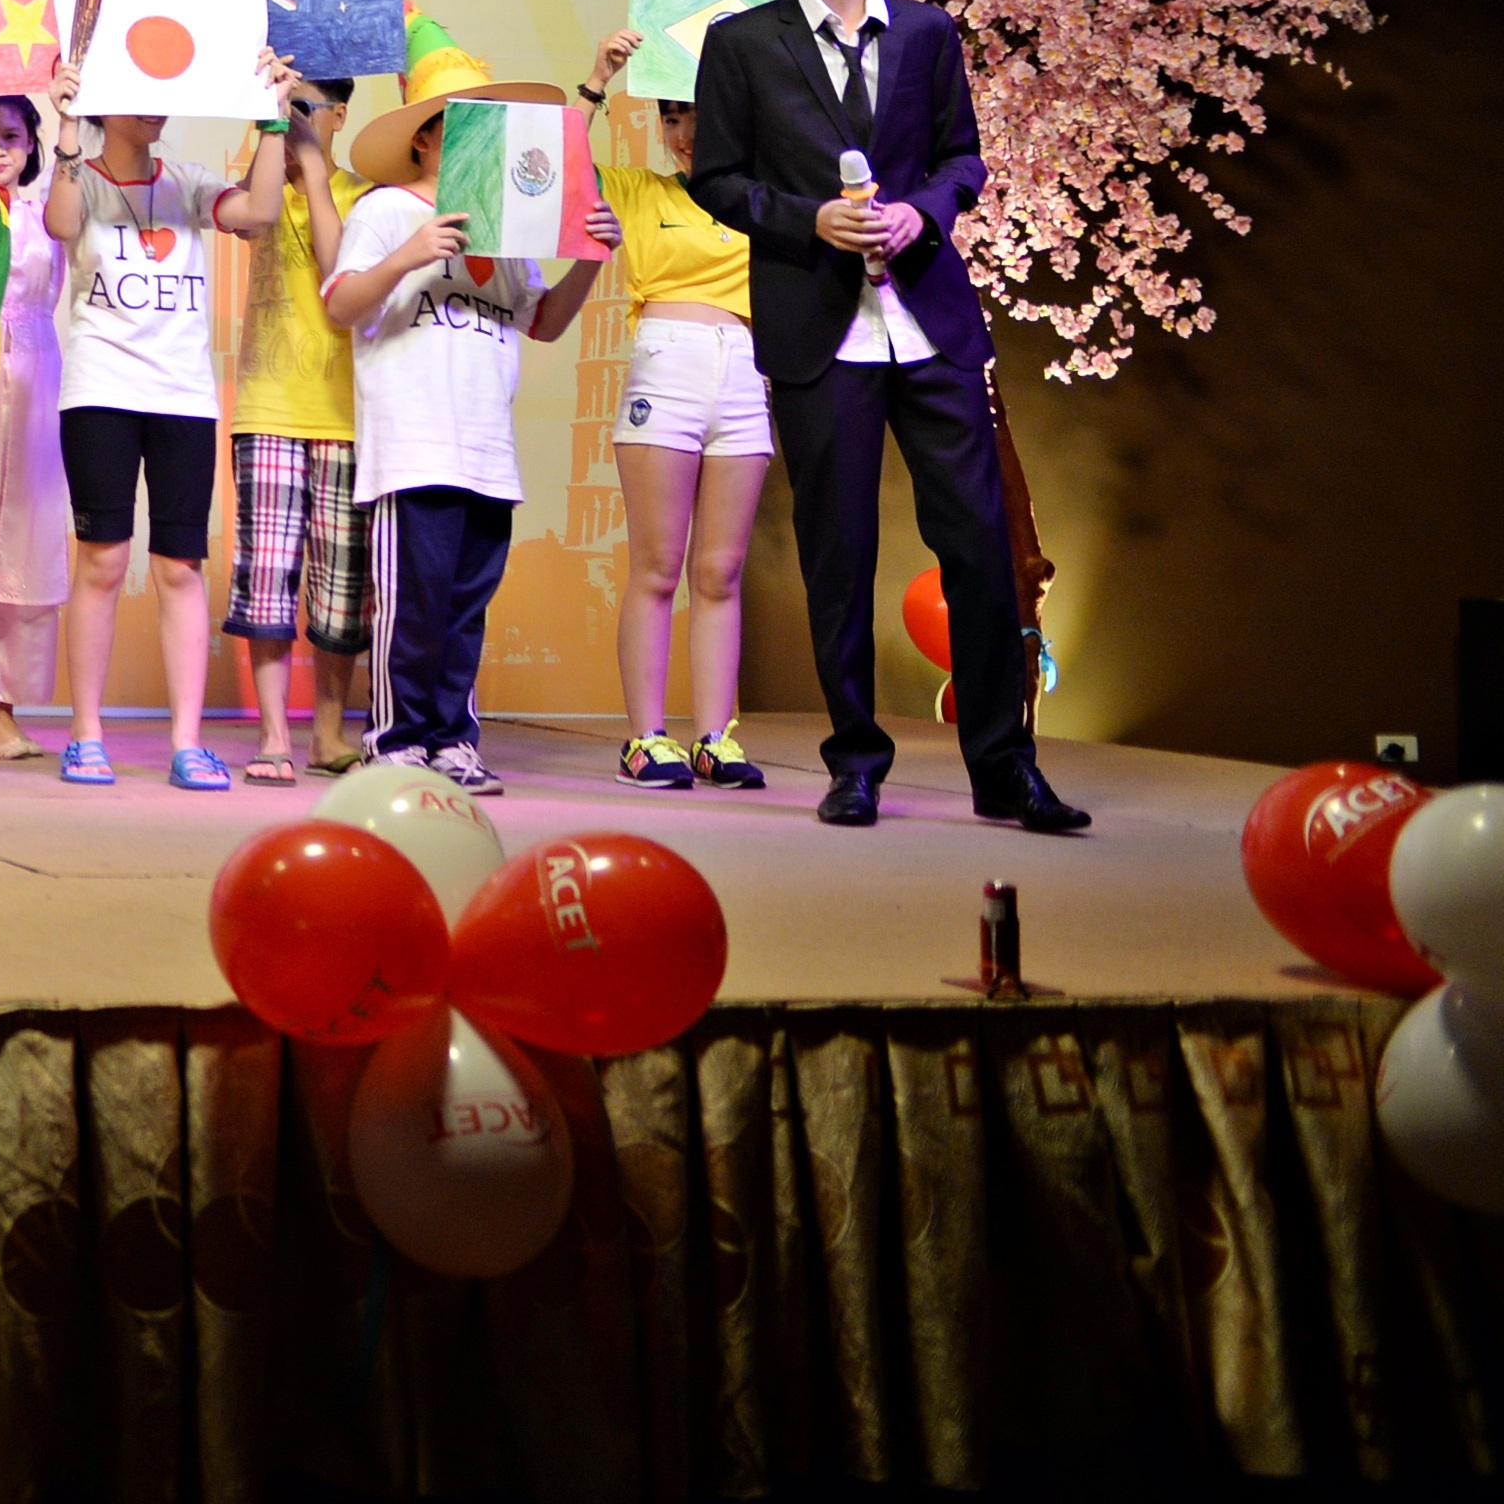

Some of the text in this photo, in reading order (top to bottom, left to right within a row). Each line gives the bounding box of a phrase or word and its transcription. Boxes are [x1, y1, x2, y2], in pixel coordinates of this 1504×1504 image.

[114, 225, 128, 261] I
[87, 272, 205, 312] ACET
[410, 290, 514, 345] ACET
[1324, 773, 1417, 840] ACET
[545, 855, 601, 956] ACET
